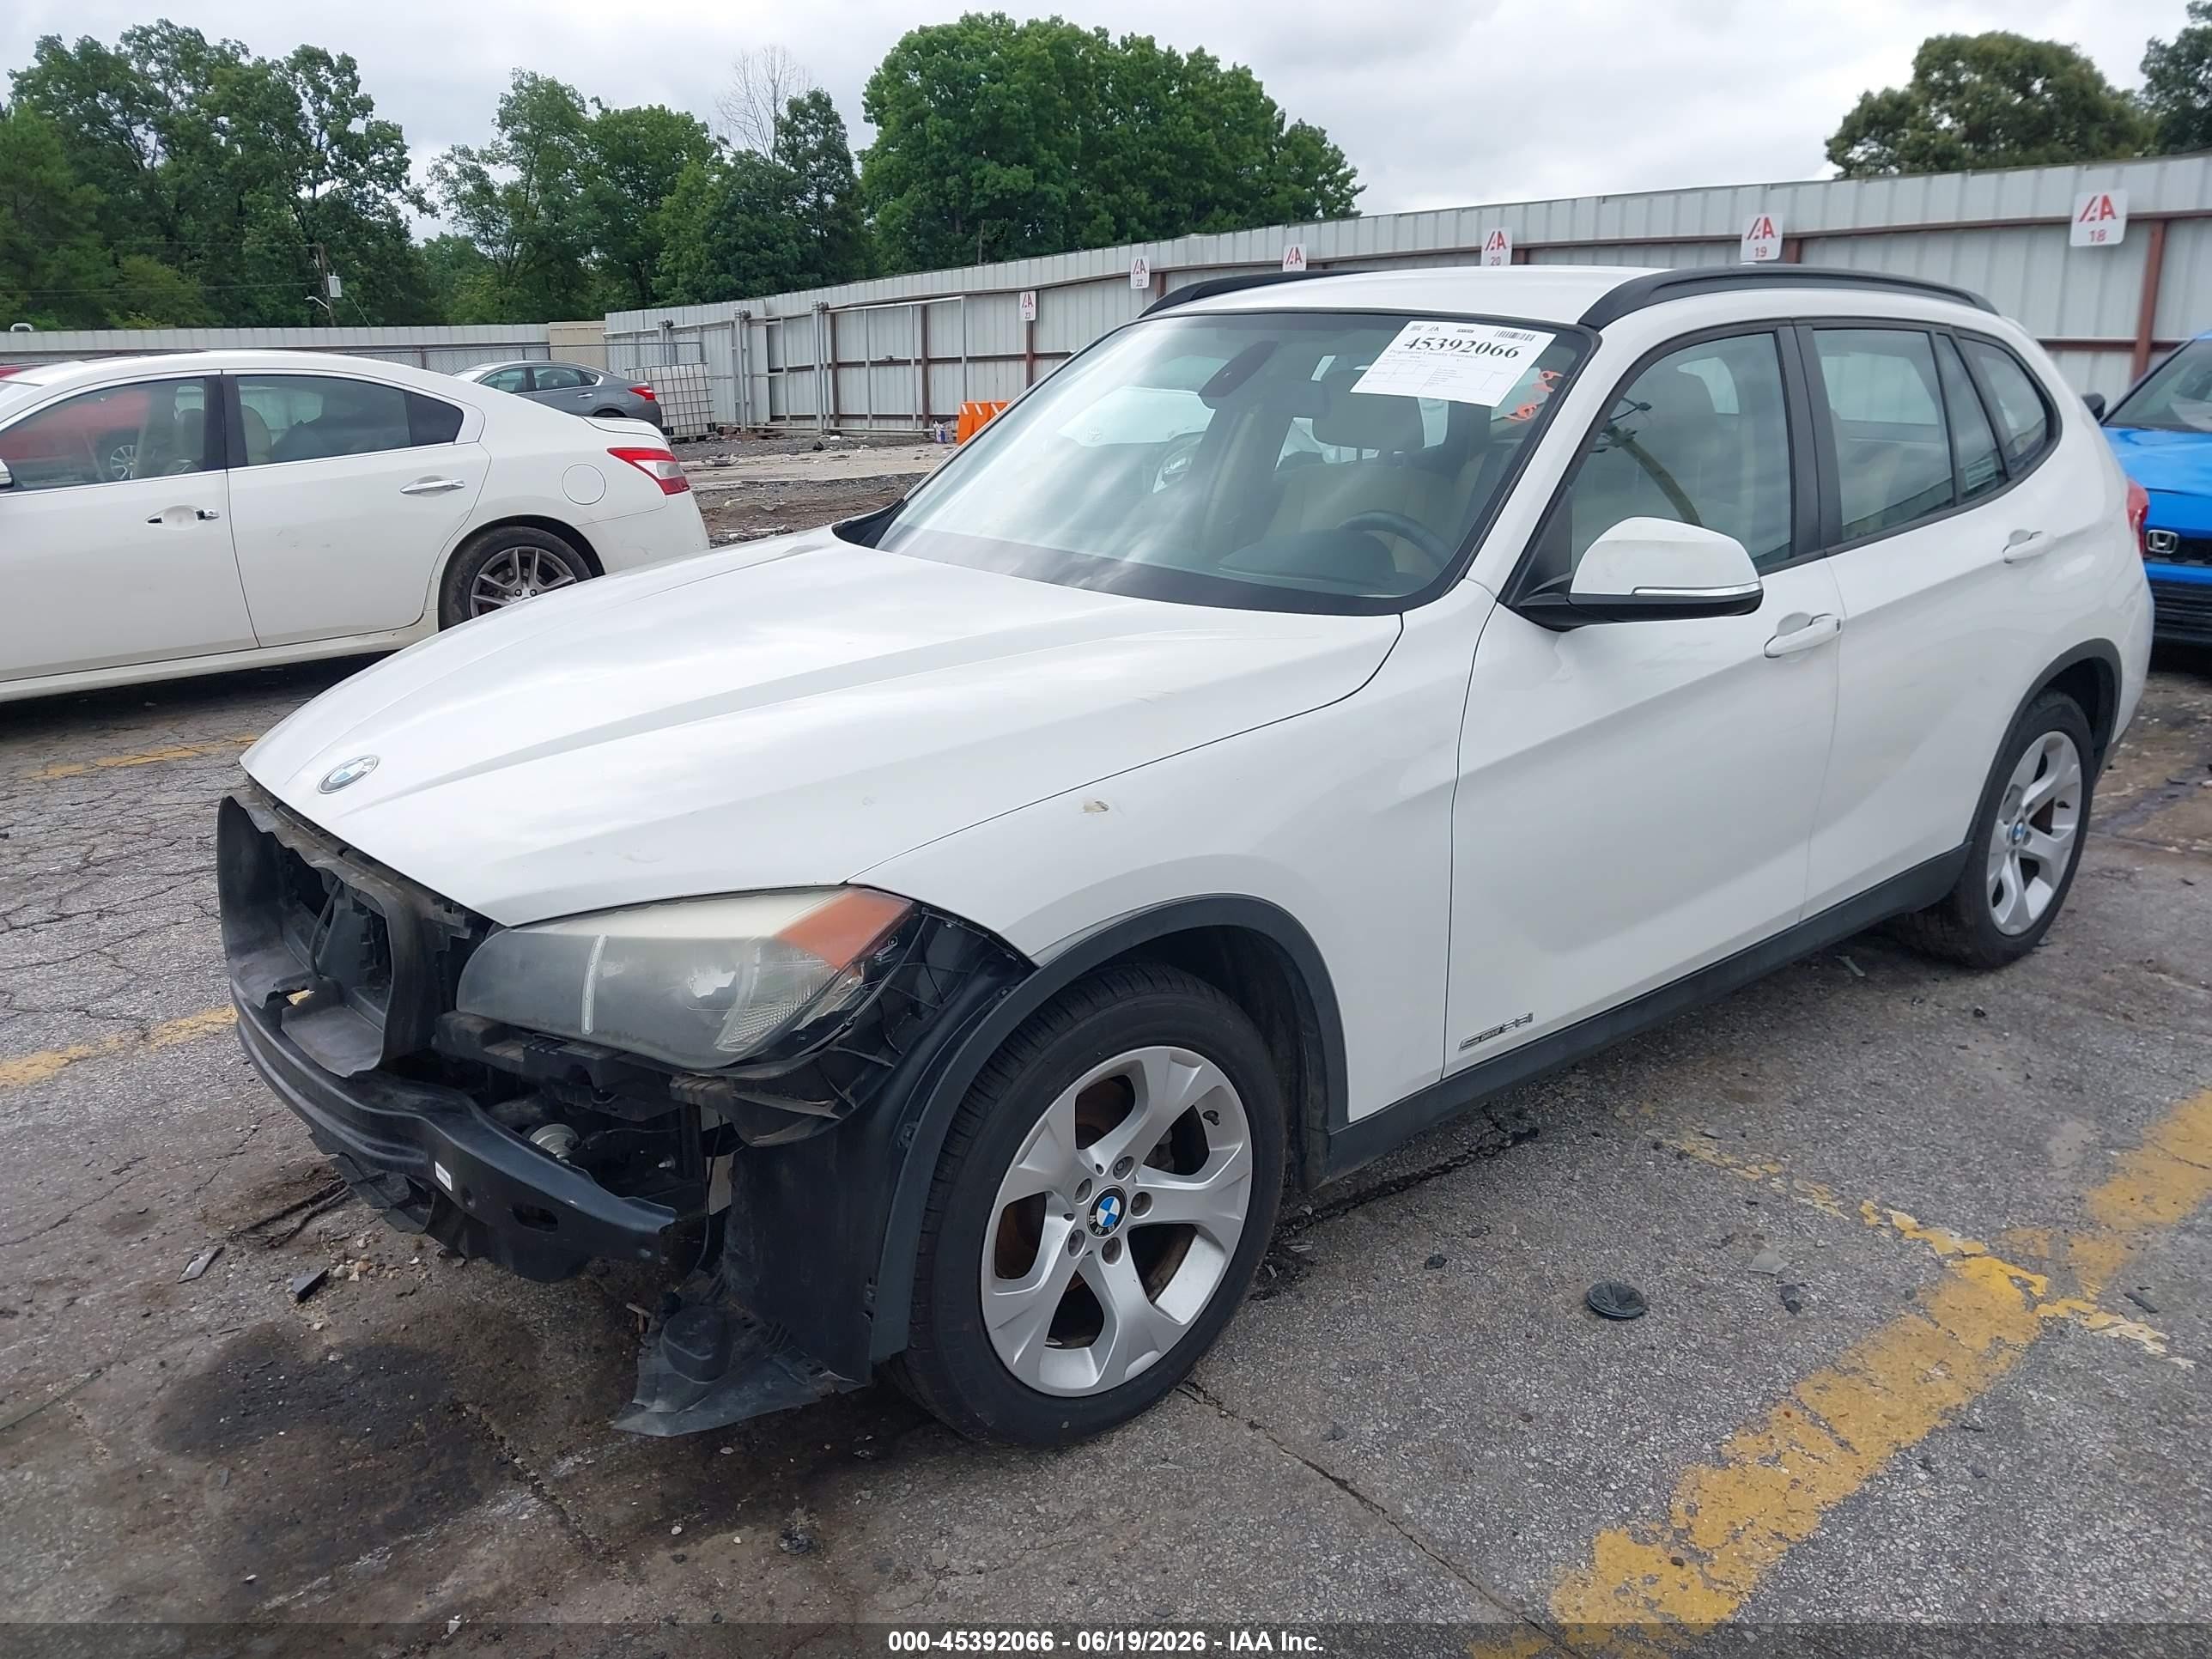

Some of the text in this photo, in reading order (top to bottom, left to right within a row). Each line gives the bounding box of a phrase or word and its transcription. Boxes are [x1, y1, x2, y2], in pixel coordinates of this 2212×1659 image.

[2089, 228, 2107, 242] 18
[1755, 246, 1767, 258] 19
[1490, 256, 1501, 266] 20
[1136, 278, 1144, 287] 22
[1404, 336, 1525, 359] 45392066
